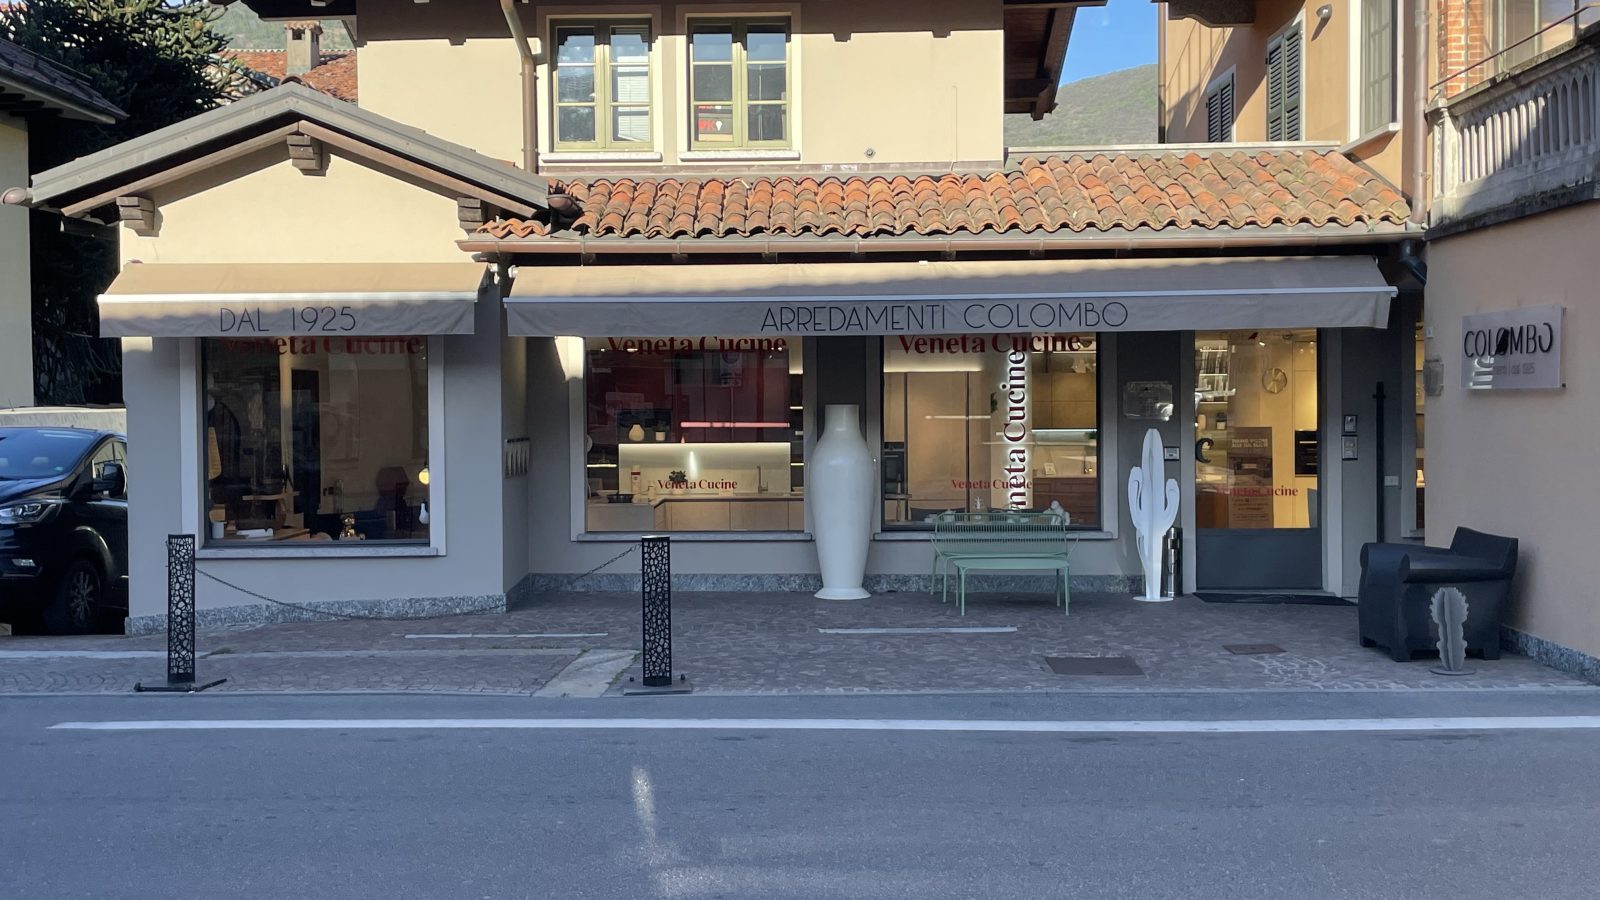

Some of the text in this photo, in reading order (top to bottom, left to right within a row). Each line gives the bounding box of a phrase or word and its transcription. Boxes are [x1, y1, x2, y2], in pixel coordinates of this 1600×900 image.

[219, 305, 357, 332] DAL 1925
[760, 301, 1128, 332] ARREDAMENTI COLOMBO
[607, 335, 787, 355] Veneta Cucine
[899, 332, 1081, 354] Veneta Cucine
[1463, 322, 1554, 358] COLOMBO
[1001, 349, 1026, 508] neta Cucine
[657, 478, 738, 490] Veneta Cucine
[951, 479, 1033, 490] Veneta Cue
